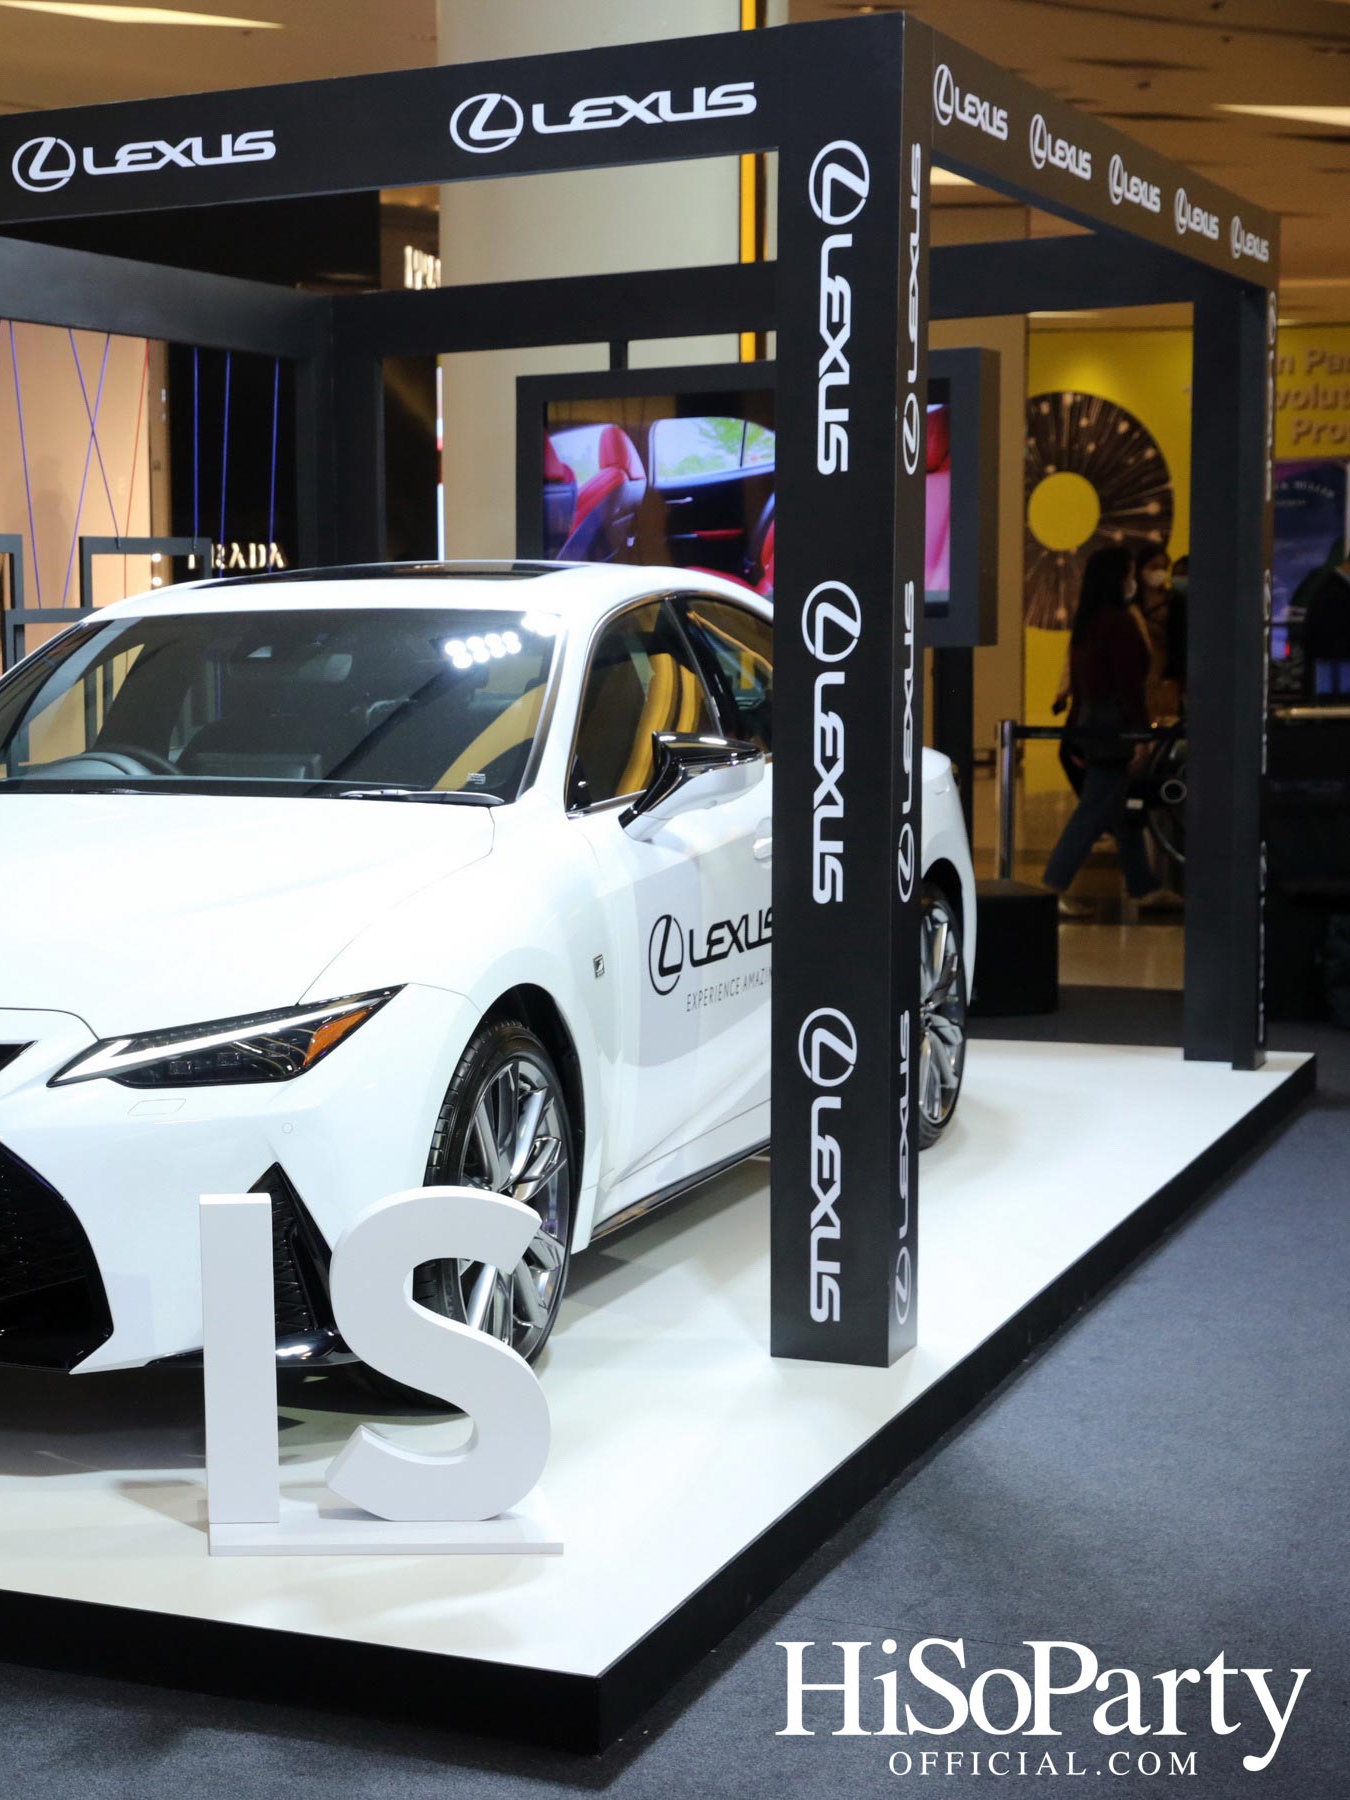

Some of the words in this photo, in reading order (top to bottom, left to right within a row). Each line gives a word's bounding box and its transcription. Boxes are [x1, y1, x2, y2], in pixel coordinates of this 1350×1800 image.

[532, 81, 757, 134] LEXUS
[954, 86, 1008, 141] LEXUS
[83, 130, 277, 176] LEXUS
[1048, 133, 1092, 181] LEXUS
[1123, 171, 1161, 213] LEXUS
[1187, 204, 1220, 240] LEXUS
[1240, 228, 1270, 263] LEXUS
[907, 143, 922, 384] LEXUS
[817, 233, 853, 476] LEXUS
[901, 580, 915, 815] LEXUS
[812, 671, 845, 905] LEXUS
[686, 977, 740, 1012] EXPERIENCE
[898, 1009, 910, 1240] LEXUS
[810, 1096, 841, 1323] LEXUS
[199, 1185, 552, 1522] IS
